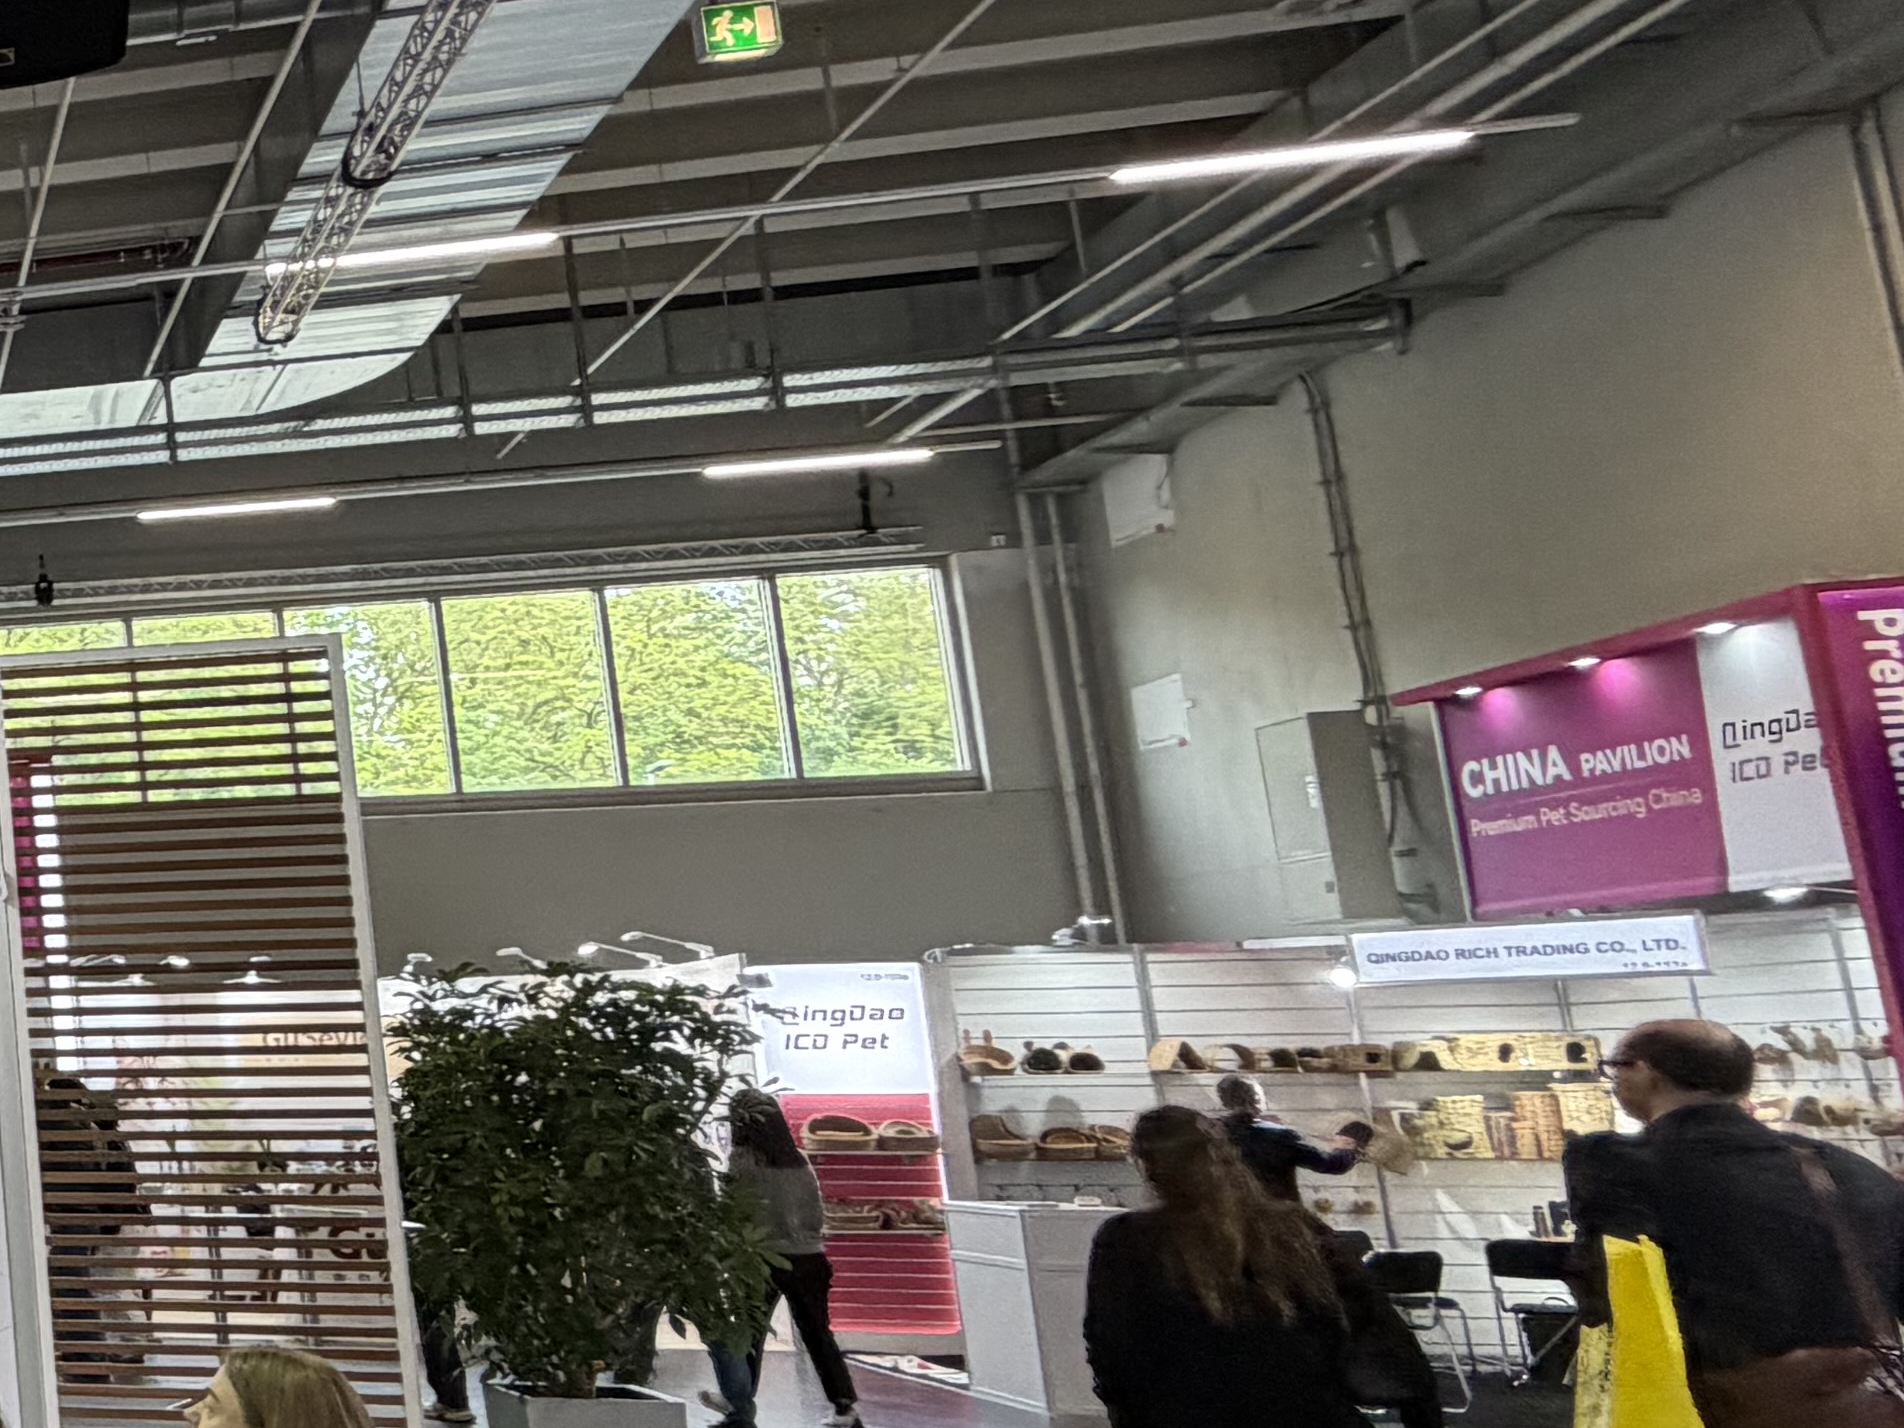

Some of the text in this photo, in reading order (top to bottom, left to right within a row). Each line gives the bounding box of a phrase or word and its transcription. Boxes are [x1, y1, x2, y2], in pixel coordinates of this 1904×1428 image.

[1722, 708, 1819, 749] QingDa
[1461, 734, 1692, 798] CHINA PAVILION
[1470, 787, 1703, 837] Premium Pet Sourcing China
[1367, 949, 1450, 964] QINGDAO
[1455, 946, 1500, 959] RICH
[1503, 943, 1590, 958] TRADING
[1642, 939, 1686, 952] LTD.
[842, 1033, 890, 1050] Pet
